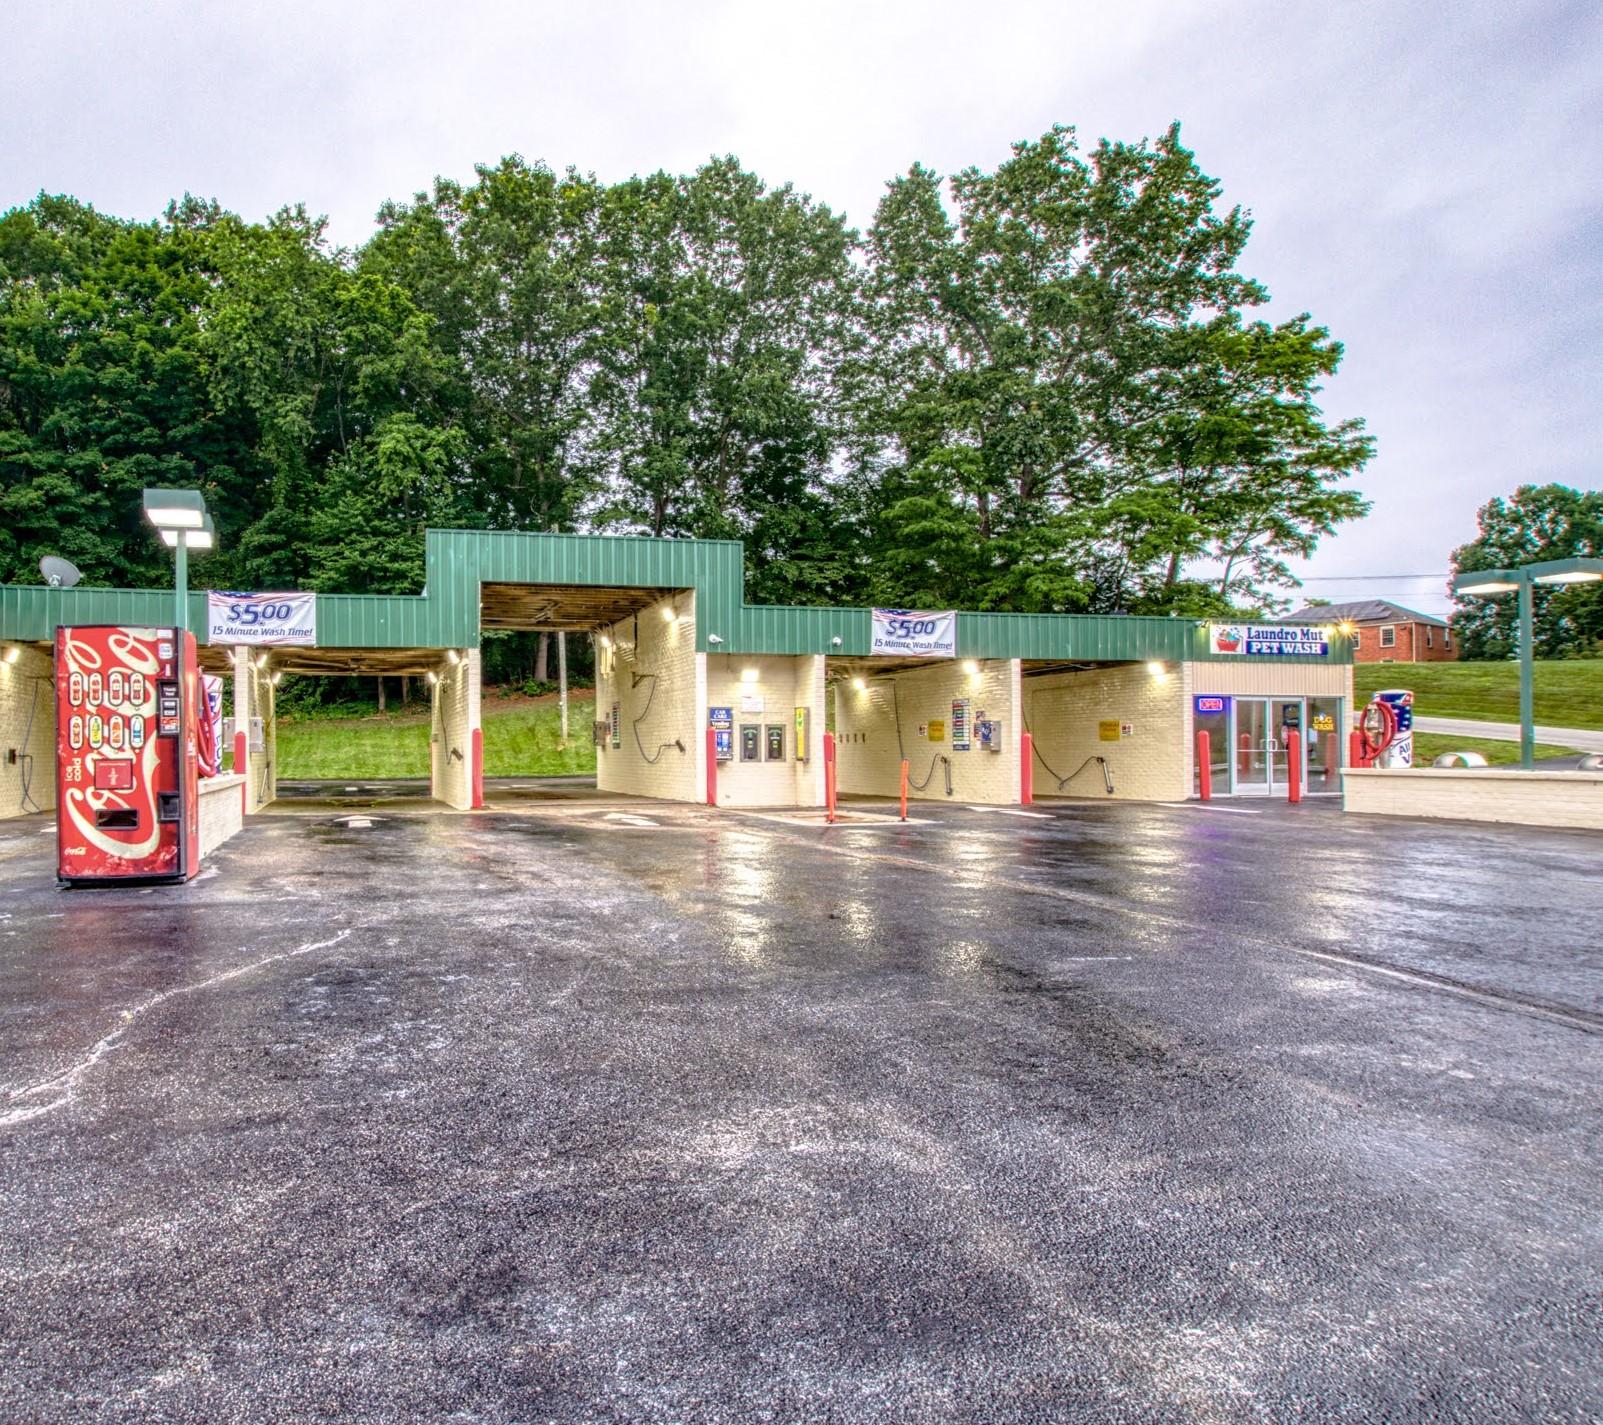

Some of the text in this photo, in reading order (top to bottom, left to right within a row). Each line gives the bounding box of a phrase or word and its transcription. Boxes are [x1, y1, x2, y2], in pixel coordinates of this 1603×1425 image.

[227, 603, 292, 625] $5.00
[212, 626, 313, 636] 15 Minute Wash Time!
[1247, 627, 1323, 641] Laundro Mut
[874, 638, 953, 650] 15 Minute Wash Time!
[1251, 642, 1322, 654] PET WASH
[1201, 700, 1220, 710] OPEN
[64, 766, 73, 781] ice
[72, 758, 82, 782] cold
